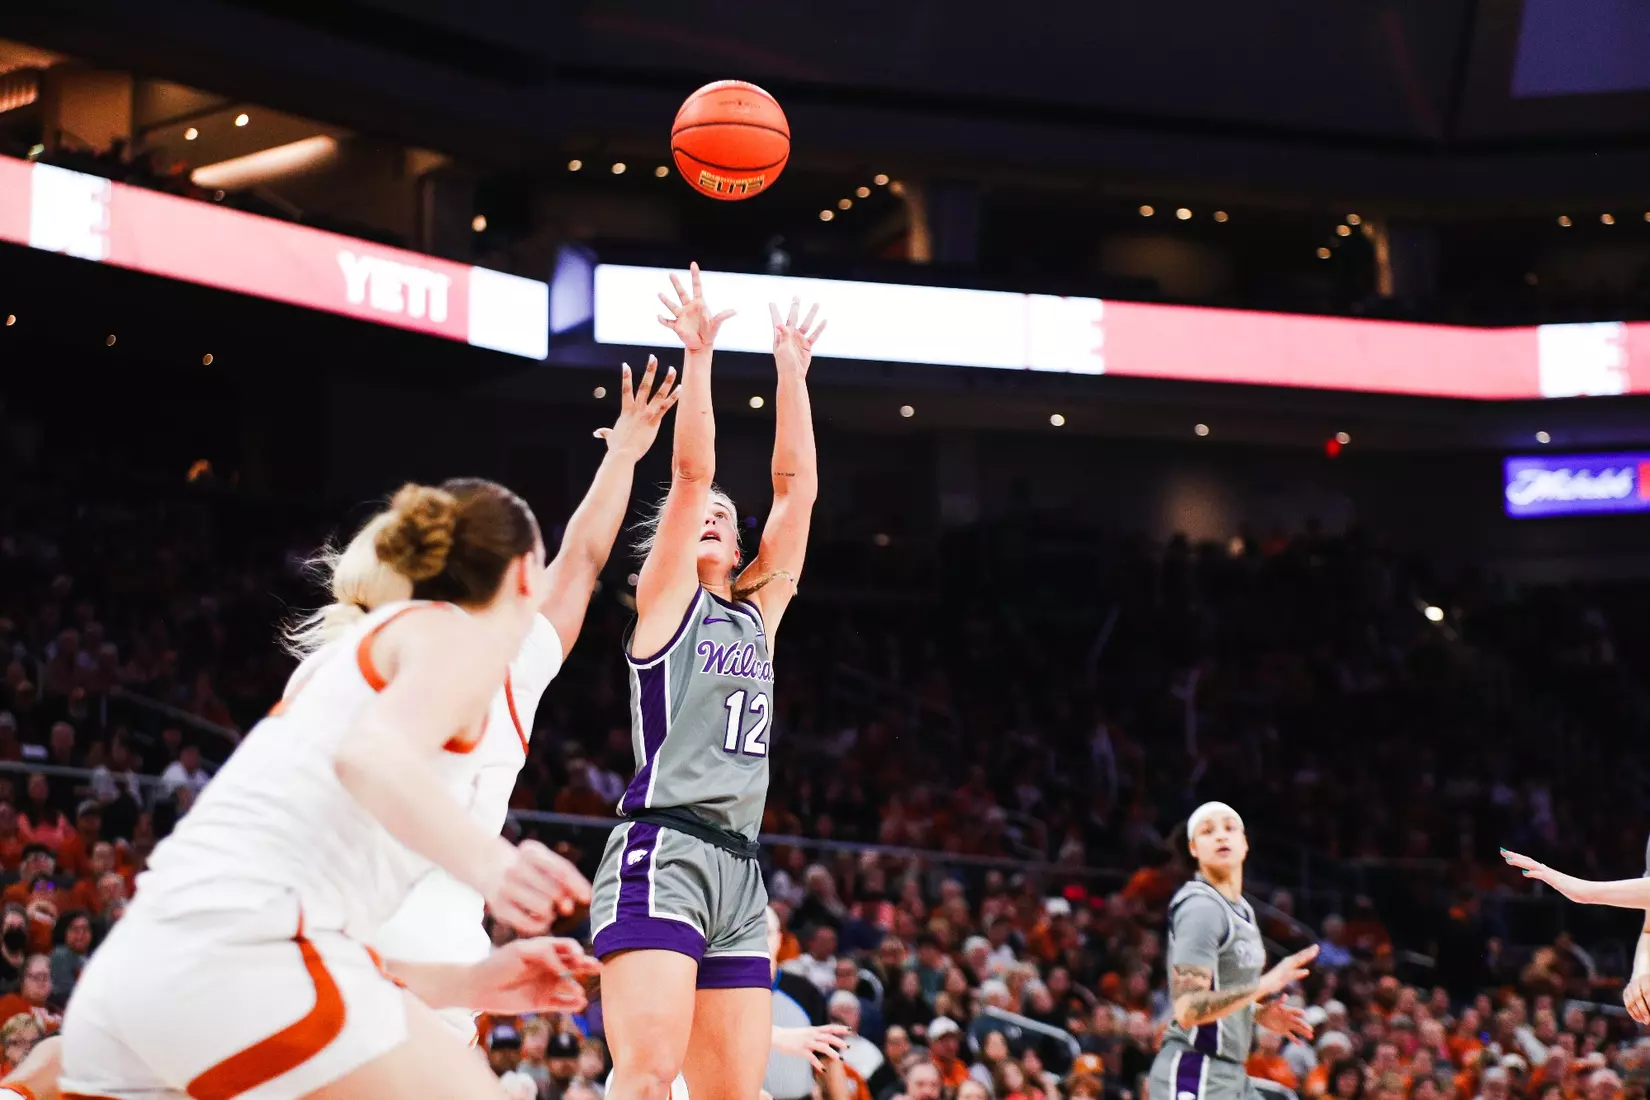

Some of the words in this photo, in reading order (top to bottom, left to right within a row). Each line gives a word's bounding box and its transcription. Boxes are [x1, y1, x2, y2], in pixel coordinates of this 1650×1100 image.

[699, 170, 765, 194] ELITE
[337, 250, 451, 323] YETI
[723, 689, 769, 758] 12
